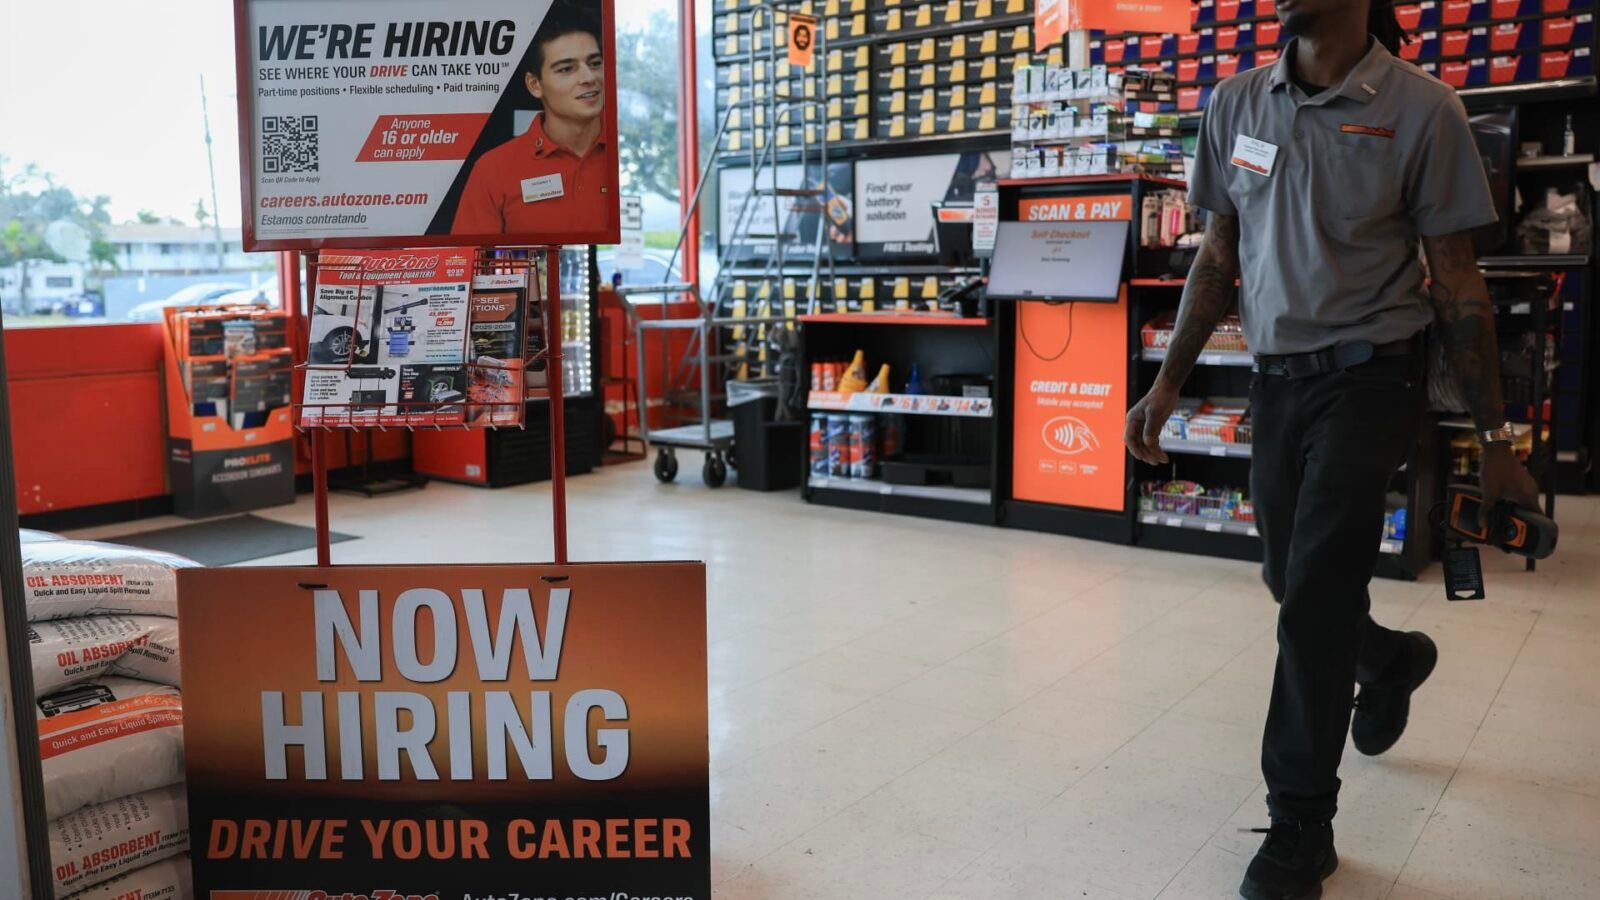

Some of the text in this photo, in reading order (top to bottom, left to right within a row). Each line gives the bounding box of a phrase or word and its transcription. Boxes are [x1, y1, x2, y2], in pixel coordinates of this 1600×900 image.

[258, 19, 516, 61] WE’RE HIRING
[259, 68, 282, 80] SEE
[285, 66, 329, 79] WHERE
[333, 65, 366, 78] YOUR
[369, 64, 408, 78] DRIVE
[412, 64, 437, 77] CAN
[441, 63, 471, 76] TAKE
[258, 82, 500, 98] Part-time positions Flexible scheduling Paid training
[391, 118, 431, 131] Anyone
[382, 129, 458, 145] 16 or older
[374, 146, 425, 160] can apply
[866, 183, 912, 195] Find your
[260, 192, 428, 209] careers.autozone.com
[866, 197, 901, 207] battery
[261, 212, 367, 226] Estamos contratando
[866, 211, 906, 221] solution
[1029, 201, 1122, 221] SCAN & PAY
[1050, 230, 1091, 239] Checkout
[359, 255, 439, 271] AutoZone
[338, 271, 356, 279] Tool
[362, 270, 401, 280] Equipment
[1030, 380, 1112, 396] CREDIT & DEBIT
[26, 575, 49, 588] OIL
[52, 574, 124, 586] ABSORBENT
[33, 588, 54, 597] Quick
[55, 587, 69, 596] and
[70, 587, 86, 596] Easy
[87, 586, 109, 595] Liquid
[109, 586, 123, 595] Spill
[312, 588, 571, 683] NOW
[57, 650, 79, 667] OIL
[64, 664, 84, 676] Quick
[86, 661, 99, 671] and
[143, 649, 169, 663] Removal
[52, 736, 79, 749] Quick
[80, 729, 97, 741] and
[98, 724, 119, 737] Easy
[120, 717, 146, 730] Liquid
[261, 689, 630, 781] HIRING
[206, 818, 692, 860] DRIVE YOUR CAREER
[56, 862, 79, 880] OIL
[82, 831, 161, 870] ABSORBENT
[63, 875, 83, 886] Quick
[100, 862, 117, 873] Easy
[119, 853, 141, 866] Liquid
